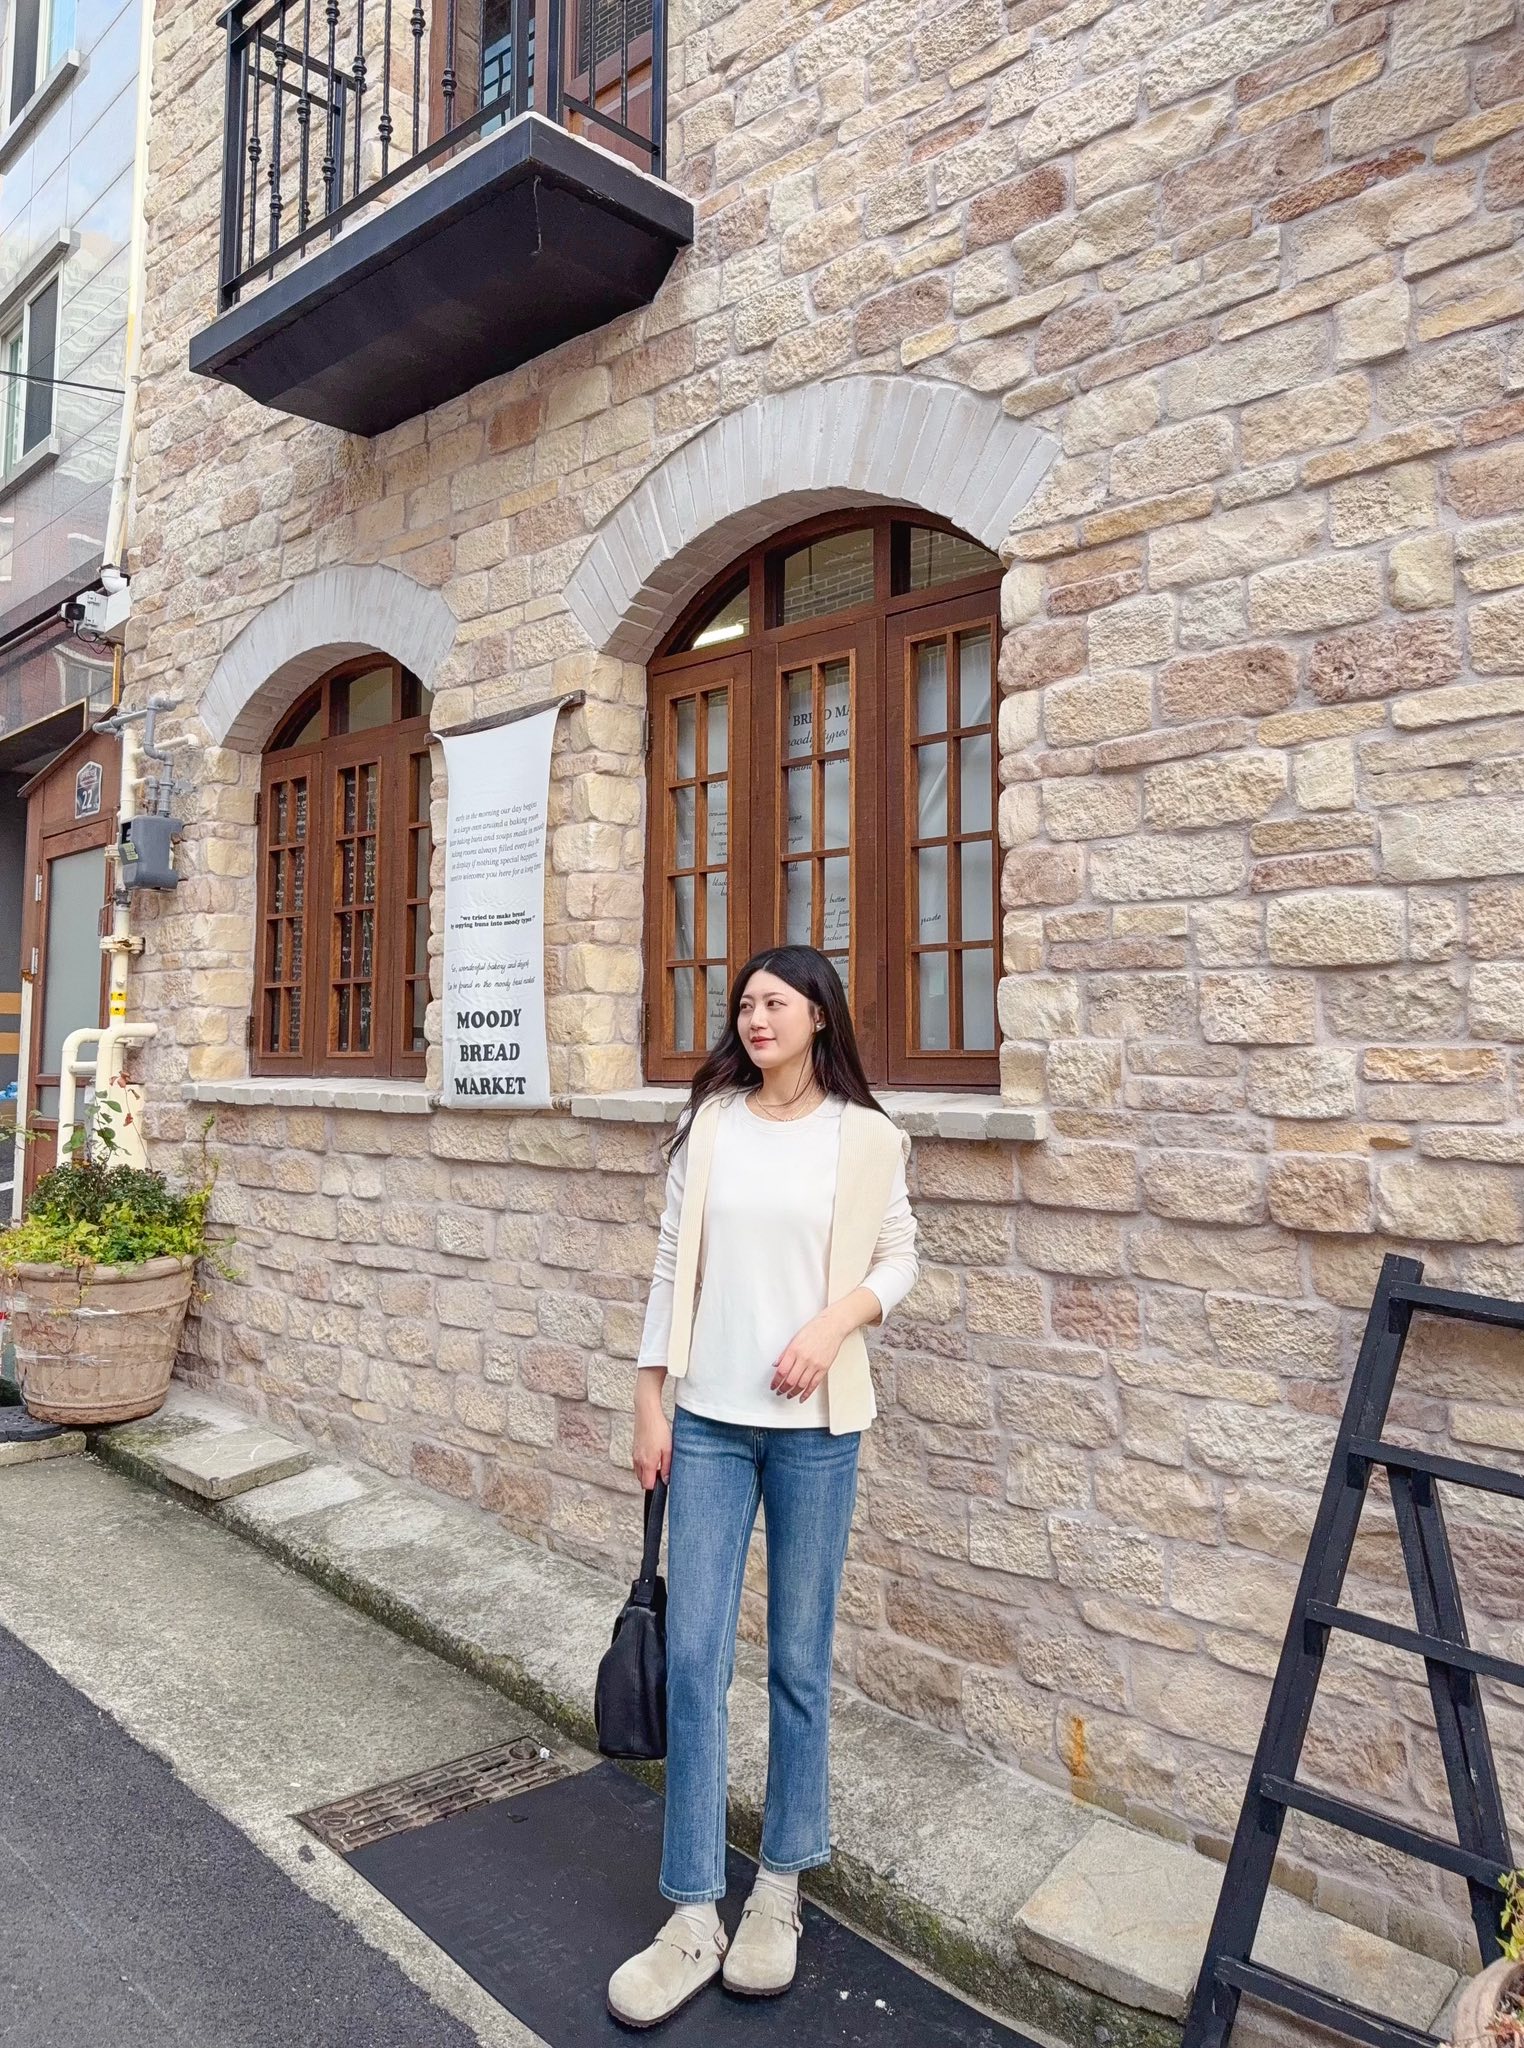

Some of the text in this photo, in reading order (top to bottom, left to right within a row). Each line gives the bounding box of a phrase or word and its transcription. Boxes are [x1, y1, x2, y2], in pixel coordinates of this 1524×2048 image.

[82, 789, 93, 810] 22
[478, 808, 500, 818] morning
[511, 804, 522, 814] day
[482, 820, 503, 830] around
[509, 818, 528, 827] baking
[483, 834, 495, 842] and
[477, 846, 498, 855] always
[498, 843, 514, 854] filled
[477, 857, 499, 867] nothing
[499, 855, 520, 866] special
[485, 872, 498, 880] you
[498, 869, 512, 877] here
[511, 867, 520, 877] for
[486, 961, 507, 975] bakery
[457, 1008, 522, 1029] MOODY
[460, 1043, 520, 1062] BREAD
[454, 1077, 526, 1095] MARKET
